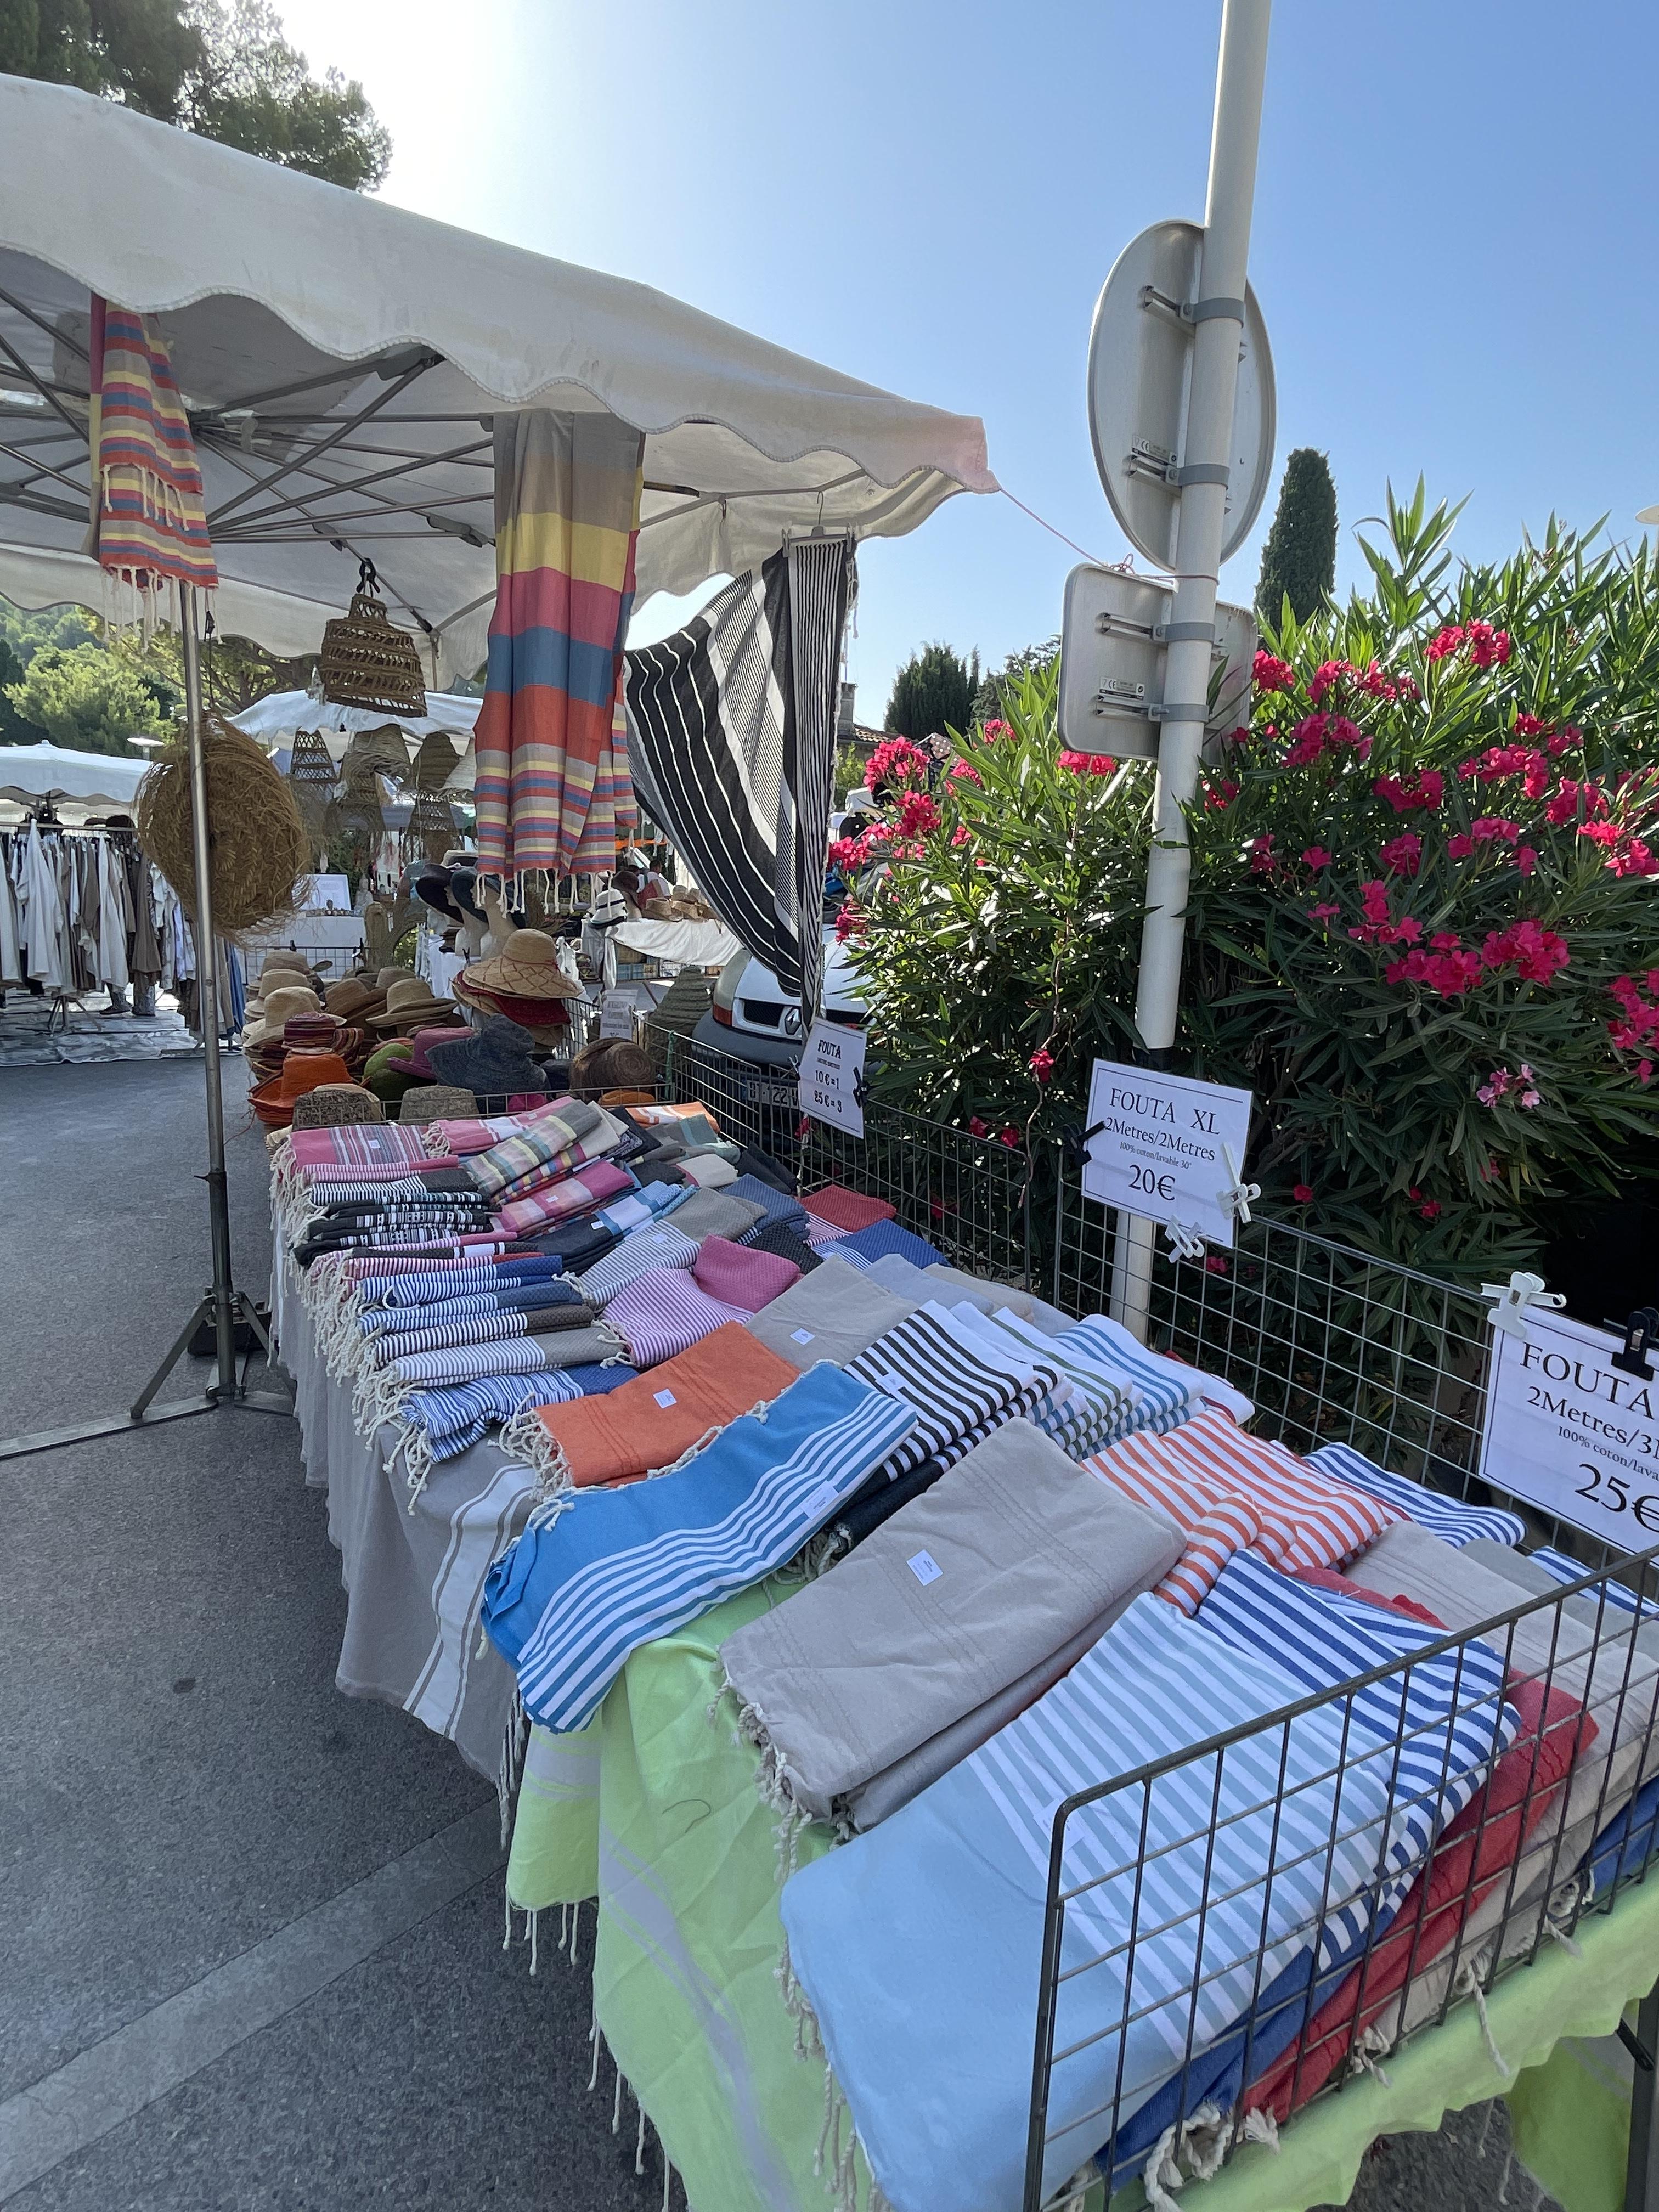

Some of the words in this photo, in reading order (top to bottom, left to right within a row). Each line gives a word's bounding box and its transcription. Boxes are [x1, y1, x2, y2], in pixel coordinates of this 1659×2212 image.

[817, 1039, 842, 1060] FOUTA
[1109, 1087, 1176, 1124] FOUTA
[1190, 1108, 1221, 1135] XL
[1105, 1116, 1216, 1161] 2Metres/2Metres
[1120, 1141, 1135, 1153] 100%
[1128, 1164, 1176, 1201] 20€
[1519, 1341, 1655, 1420] FOUTA
[1527, 1386, 1659, 1460] 2Metres/3
[1558, 1426, 1590, 1448] 100%
